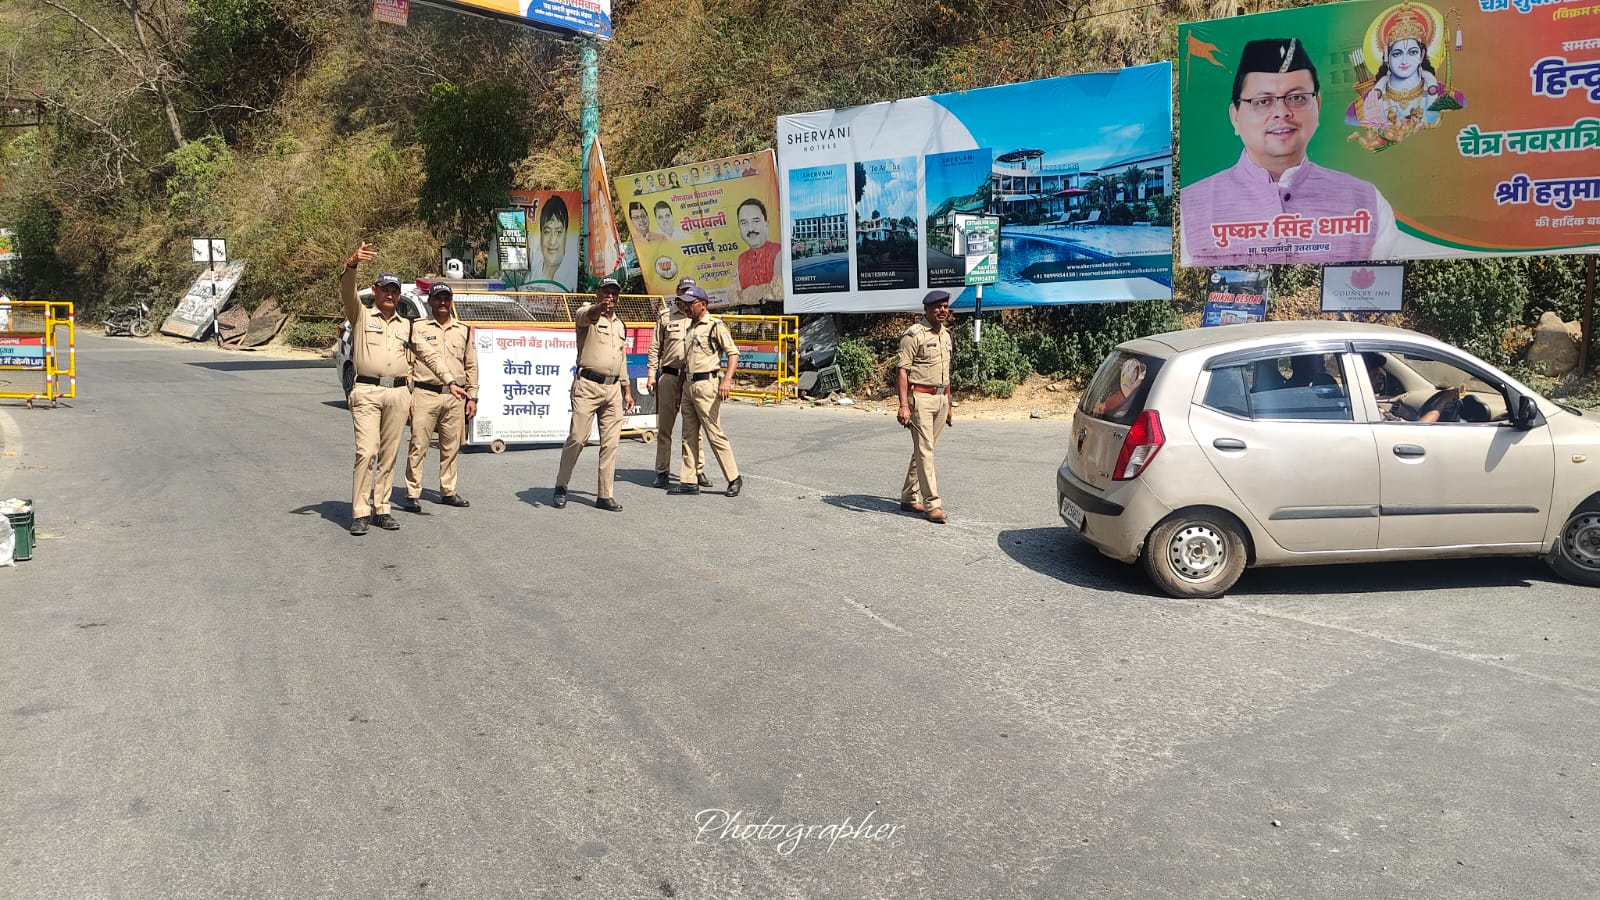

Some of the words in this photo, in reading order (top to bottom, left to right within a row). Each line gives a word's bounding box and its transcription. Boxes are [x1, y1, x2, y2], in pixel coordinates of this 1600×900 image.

[787, 126, 851, 145] SHERVANI
[1459, 126, 1503, 155] चैत्र
[1507, 118, 1600, 152] नवरात्रि
[803, 142, 837, 152] HOTELS
[802, 170, 833, 179] SHERVANI
[879, 163, 901, 172] Arha
[1496, 175, 1530, 203] श्री
[1534, 178, 1600, 209] हनुमा
[680, 211, 727, 231] दीपावली
[1212, 222, 1268, 248] पुष्कर
[1273, 214, 1313, 239] सिंह
[1319, 209, 1371, 235] धामी
[1535, 216, 1549, 228] की
[1552, 215, 1585, 228] हार्दिक
[681, 238, 715, 256] नववर्ष
[717, 242, 738, 252] 2026
[1209, 292, 1235, 302] SHIKHA
[1235, 293, 1264, 304] RESORT
[1374, 289, 1391, 297] INN
[496, 335, 527, 350] खुटानी
[545, 336, 576, 349] (भीमता
[503, 359, 532, 375] कैंची
[535, 364, 560, 376] धाम
[502, 380, 552, 400] मुक्तेश्वर
[502, 400, 551, 419] अल्मोड़ा
